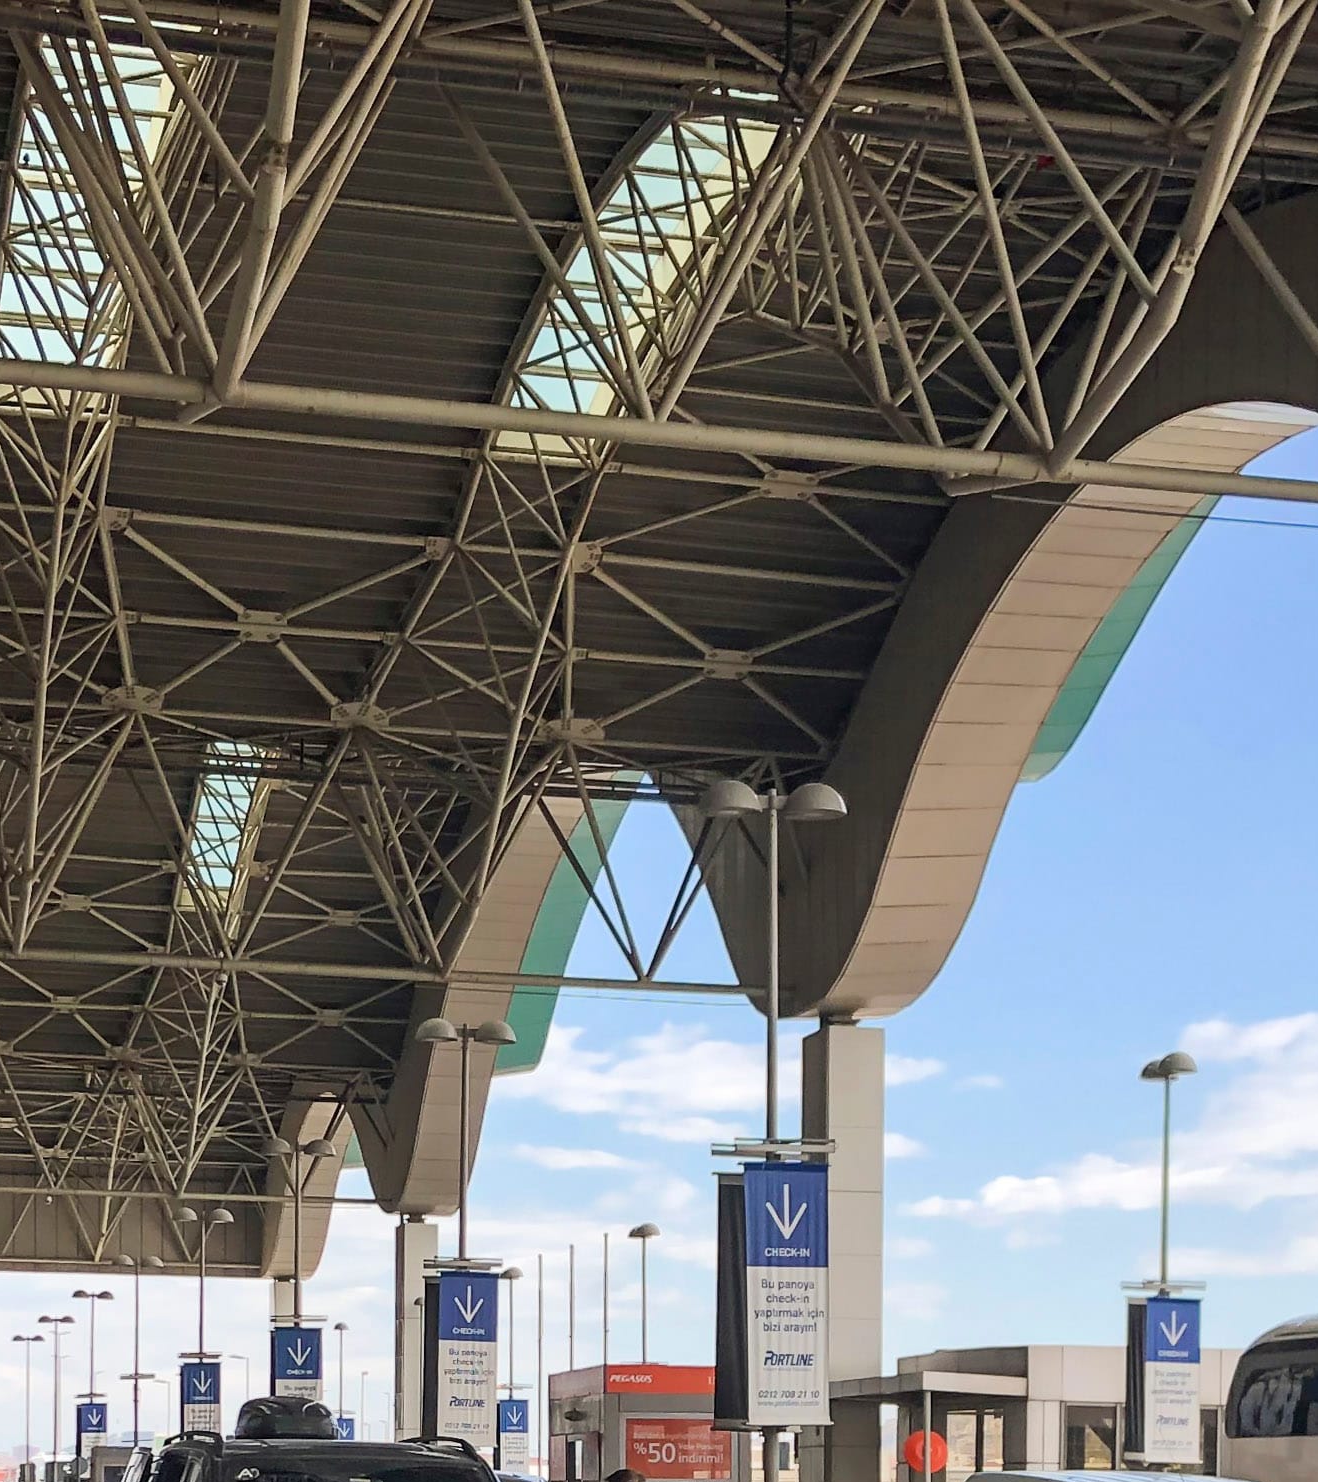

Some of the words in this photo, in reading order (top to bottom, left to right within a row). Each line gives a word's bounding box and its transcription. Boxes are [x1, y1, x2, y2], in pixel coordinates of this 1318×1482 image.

[764, 1247, 811, 1257] CHECK-IN
[761, 1279, 774, 1288] Bu
[778, 1281, 815, 1291] panoya
[766, 1294, 810, 1303] check-in
[763, 1322, 780, 1332] bizi
[763, 1350, 814, 1366] PORTLINE
[610, 1373, 653, 1384] PEGASUS
